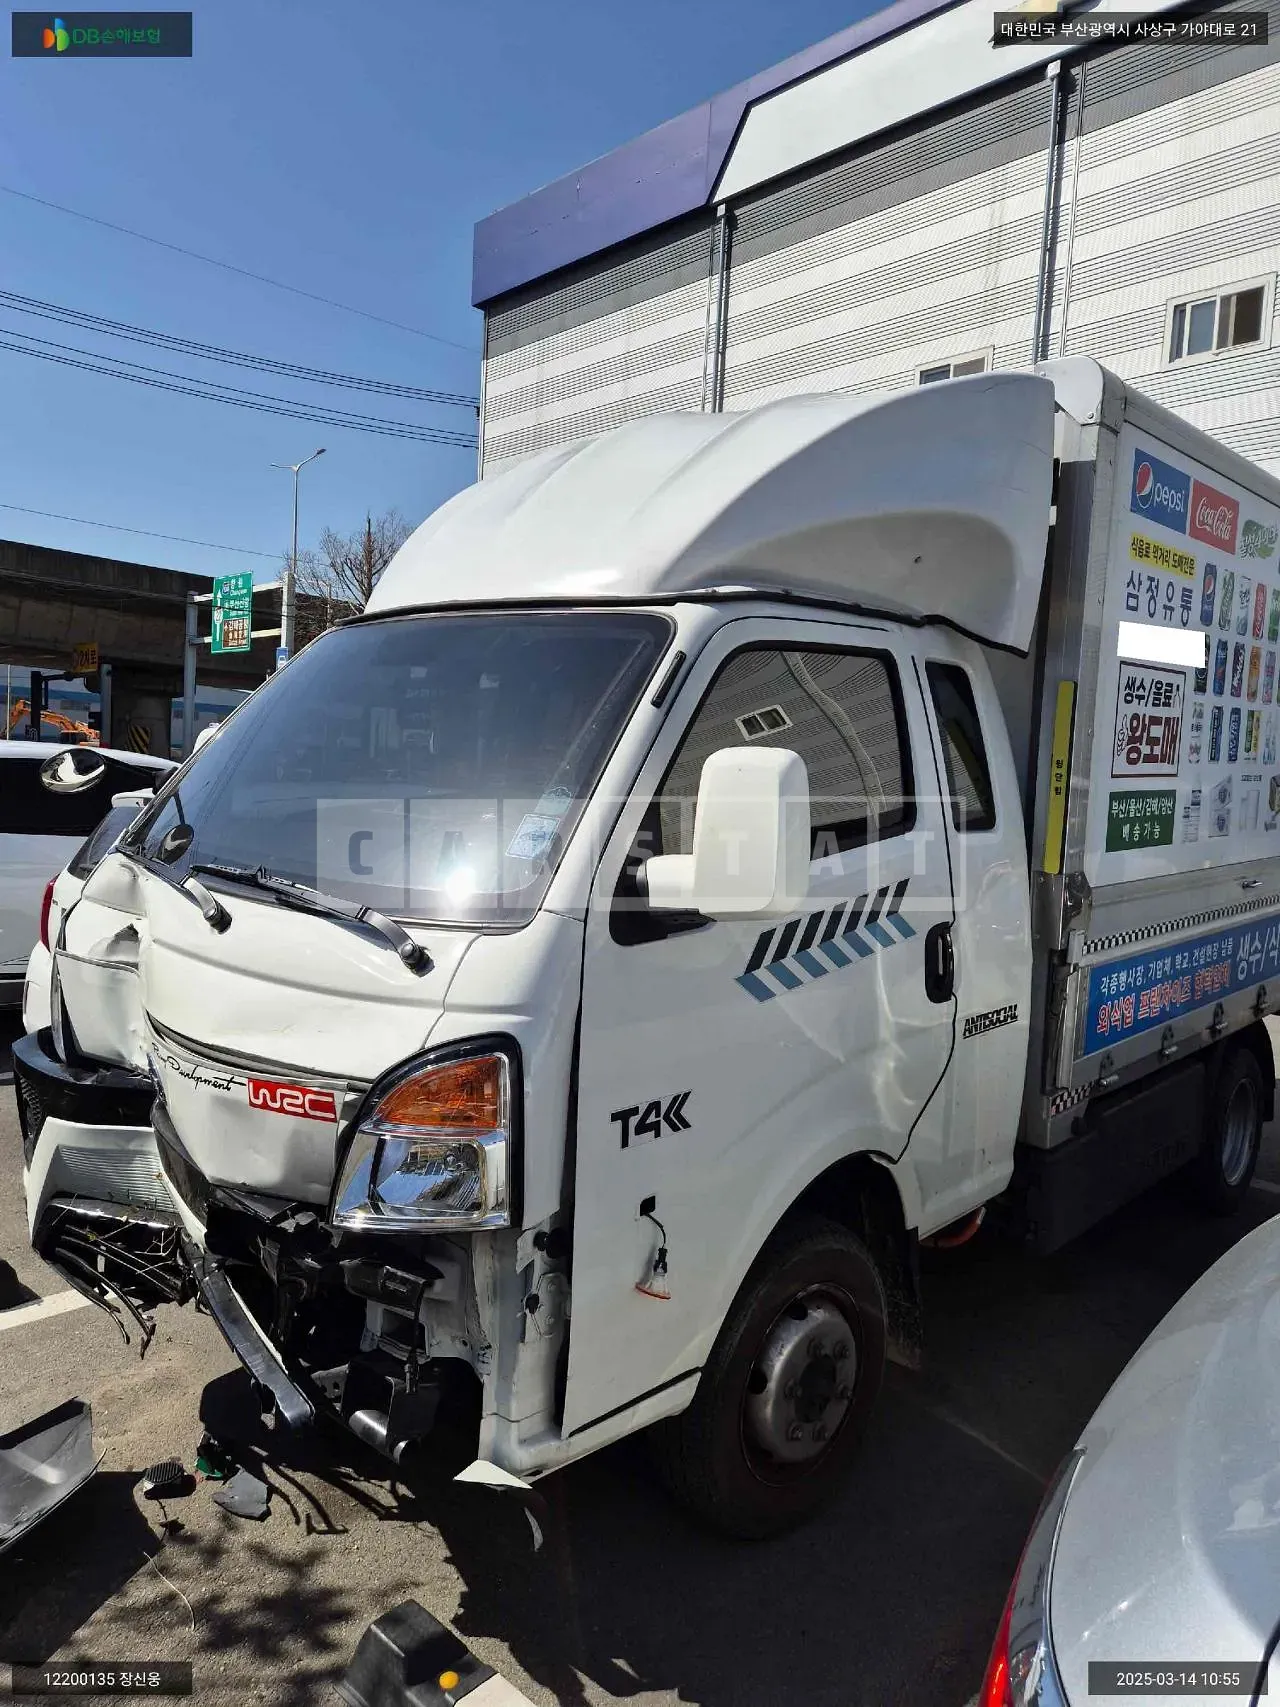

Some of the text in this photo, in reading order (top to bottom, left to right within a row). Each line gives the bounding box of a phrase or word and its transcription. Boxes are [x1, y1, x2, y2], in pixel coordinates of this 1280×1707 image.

[1154, 482, 1185, 512] pepsi
[1126, 570, 1194, 627] 삼정유통
[1124, 675, 1174, 708] 생수/음료
[1126, 712, 1179, 766] 왕도매
[1097, 993, 1136, 1036] 외식업
[249, 1082, 336, 1118] WRC
